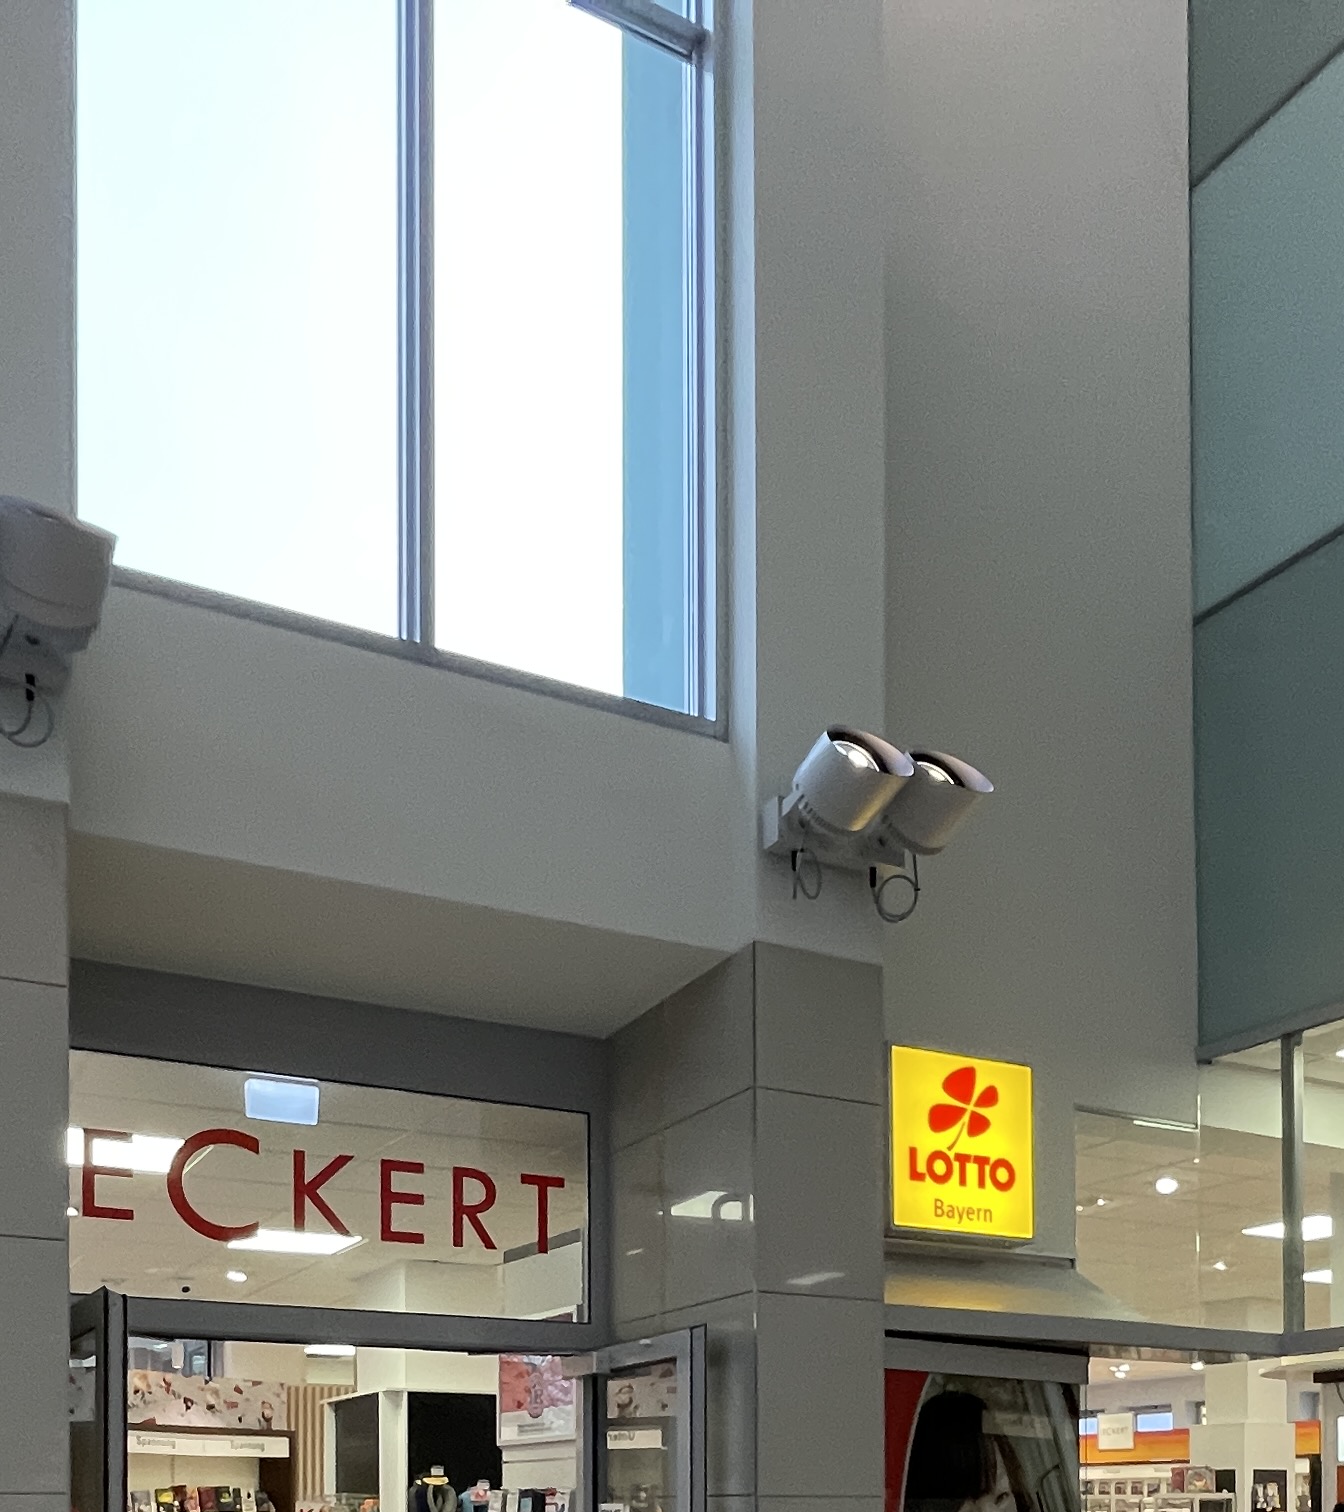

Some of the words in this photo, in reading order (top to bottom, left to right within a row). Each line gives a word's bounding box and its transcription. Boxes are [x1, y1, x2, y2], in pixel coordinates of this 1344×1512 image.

[81, 1127, 566, 1255] ECKERT
[908, 1146, 1016, 1192] LOTTO
[933, 1197, 993, 1225] Bayern
